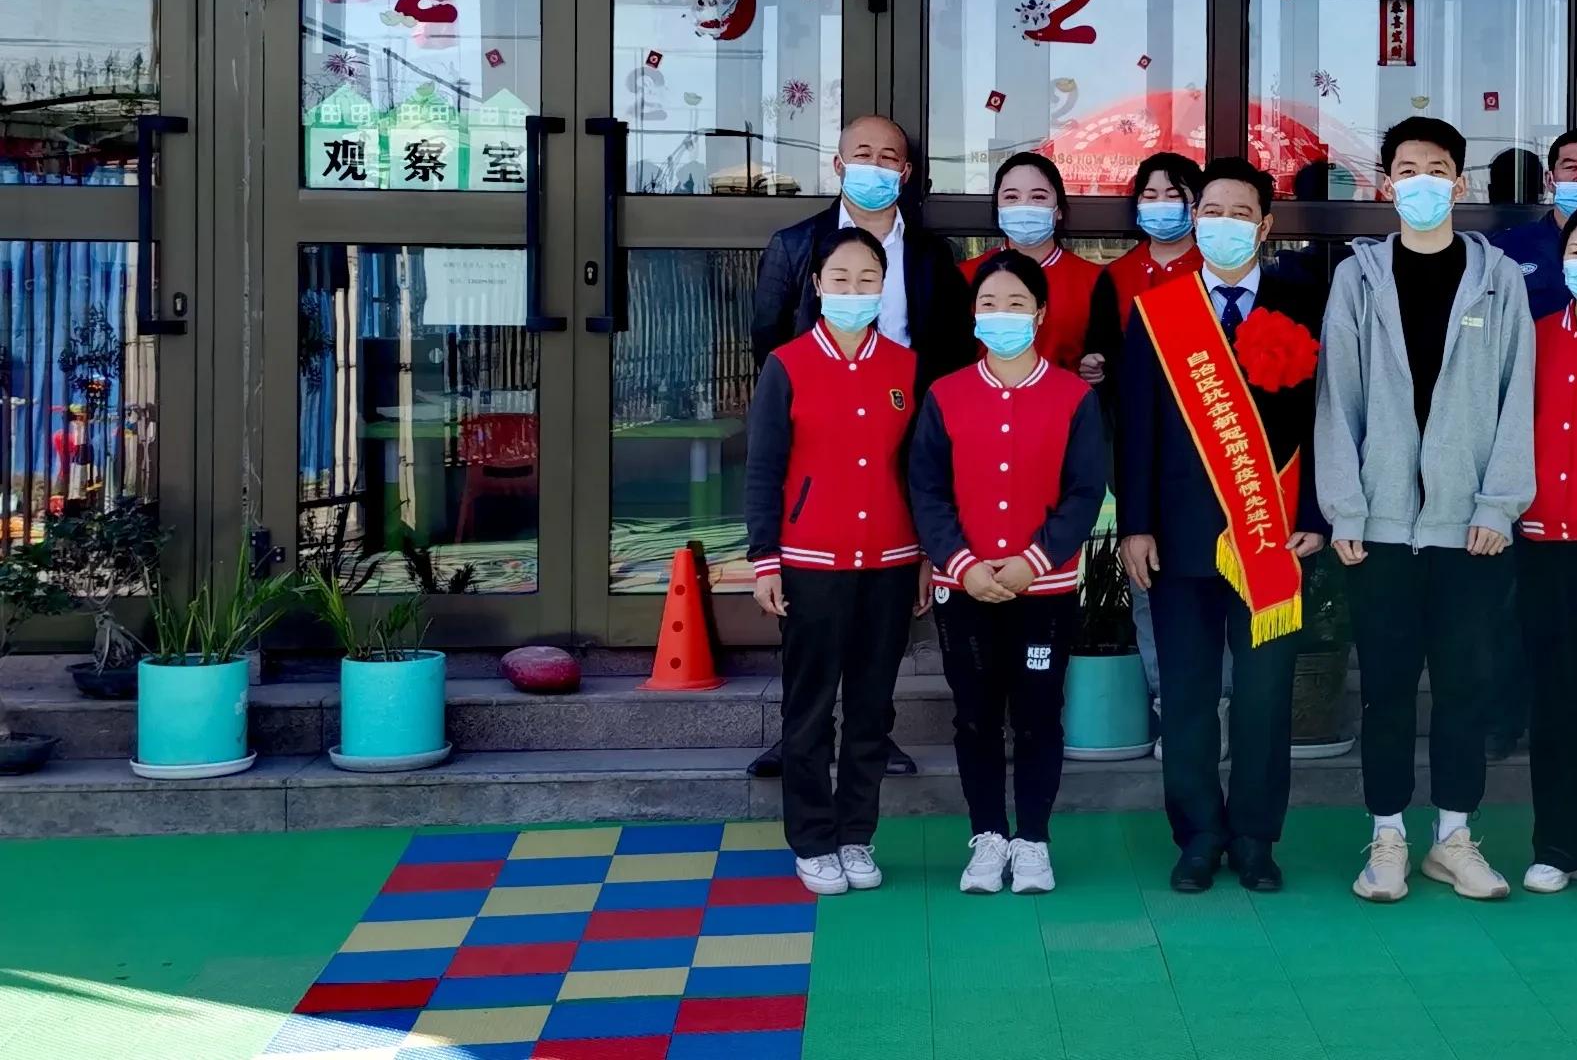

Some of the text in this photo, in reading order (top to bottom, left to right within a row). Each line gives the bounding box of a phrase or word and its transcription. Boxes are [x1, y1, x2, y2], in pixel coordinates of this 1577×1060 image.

[322, 139, 526, 184] 观察室
[1187, 350, 1277, 555] 自治区抗击新冠肺炎疫情先进个人
[1026, 658, 1051, 671] CALM
[1027, 646, 1052, 659] KEEP
